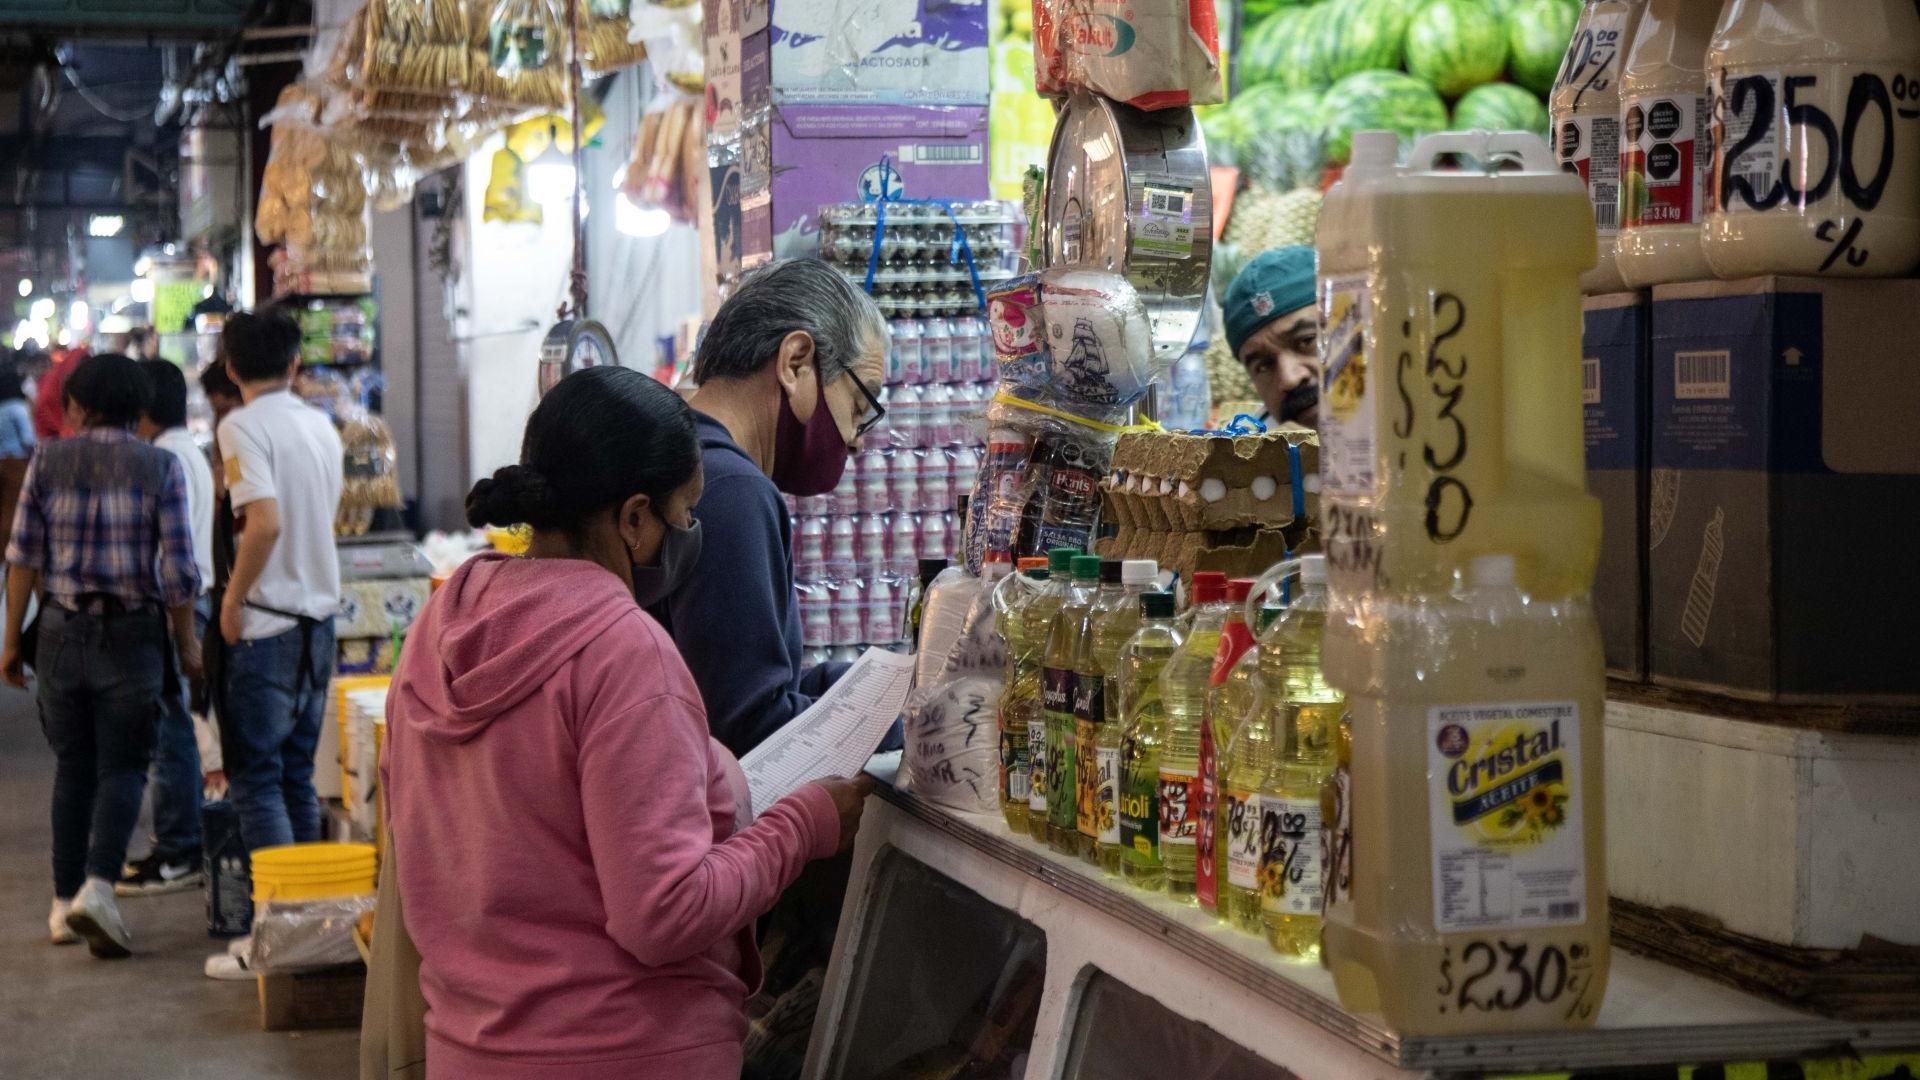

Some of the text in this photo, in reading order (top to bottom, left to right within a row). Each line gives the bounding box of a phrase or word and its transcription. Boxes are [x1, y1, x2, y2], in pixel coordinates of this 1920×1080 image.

[845, 56, 930, 68] LACTOSADA
[1654, 206, 1681, 220] 3.4 kg
[1815, 217, 1868, 272] c/u
[1473, 708, 1514, 721] VEGETAL
[1516, 706, 1573, 719] COMESTIBLE
[1448, 719, 1561, 796] Cristal
[1480, 774, 1539, 811] ACEITE
